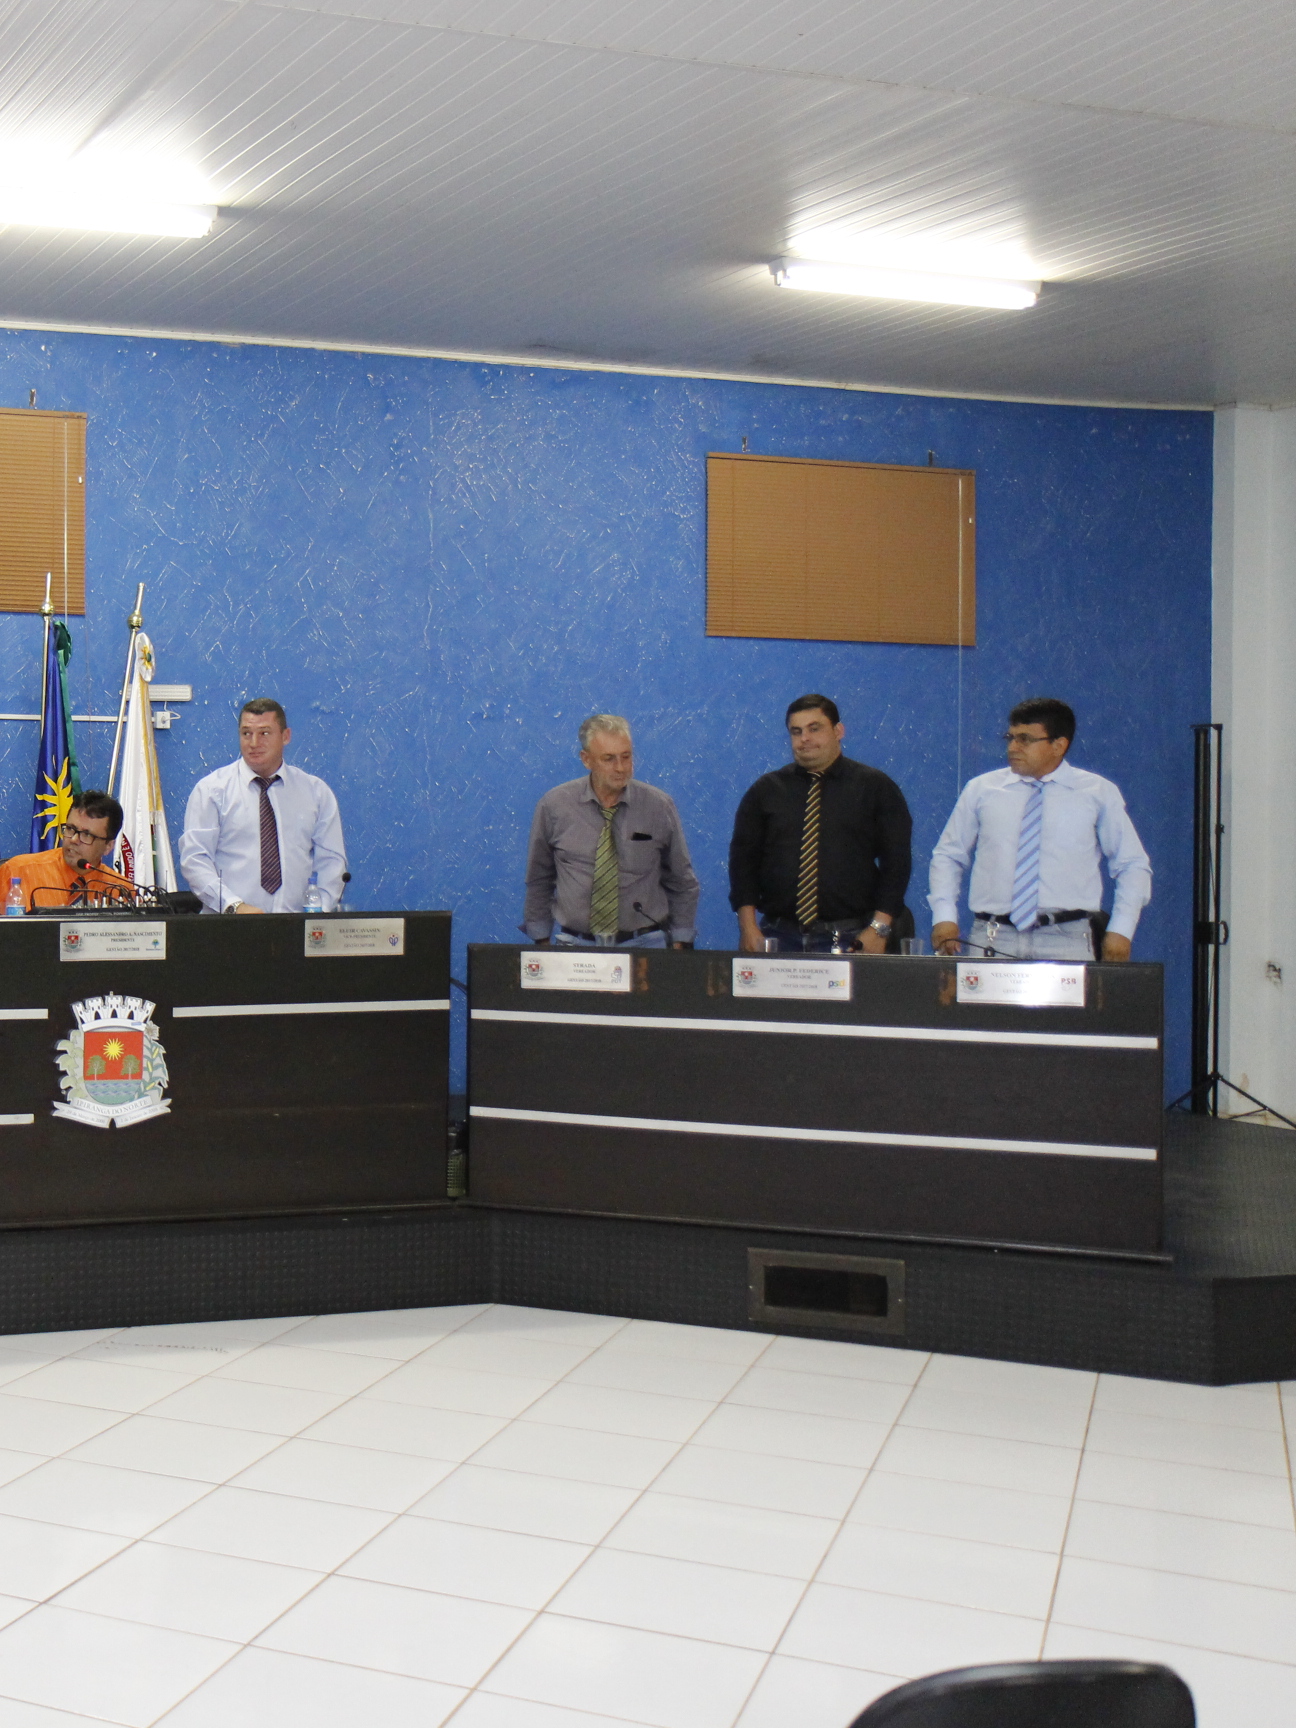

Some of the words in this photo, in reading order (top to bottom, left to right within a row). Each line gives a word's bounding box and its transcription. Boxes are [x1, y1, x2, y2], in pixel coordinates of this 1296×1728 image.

[828, 979, 846, 989] psd
[77, 1099, 110, 1115] IPIRANGA
[124, 1099, 148, 1111] NORTE
